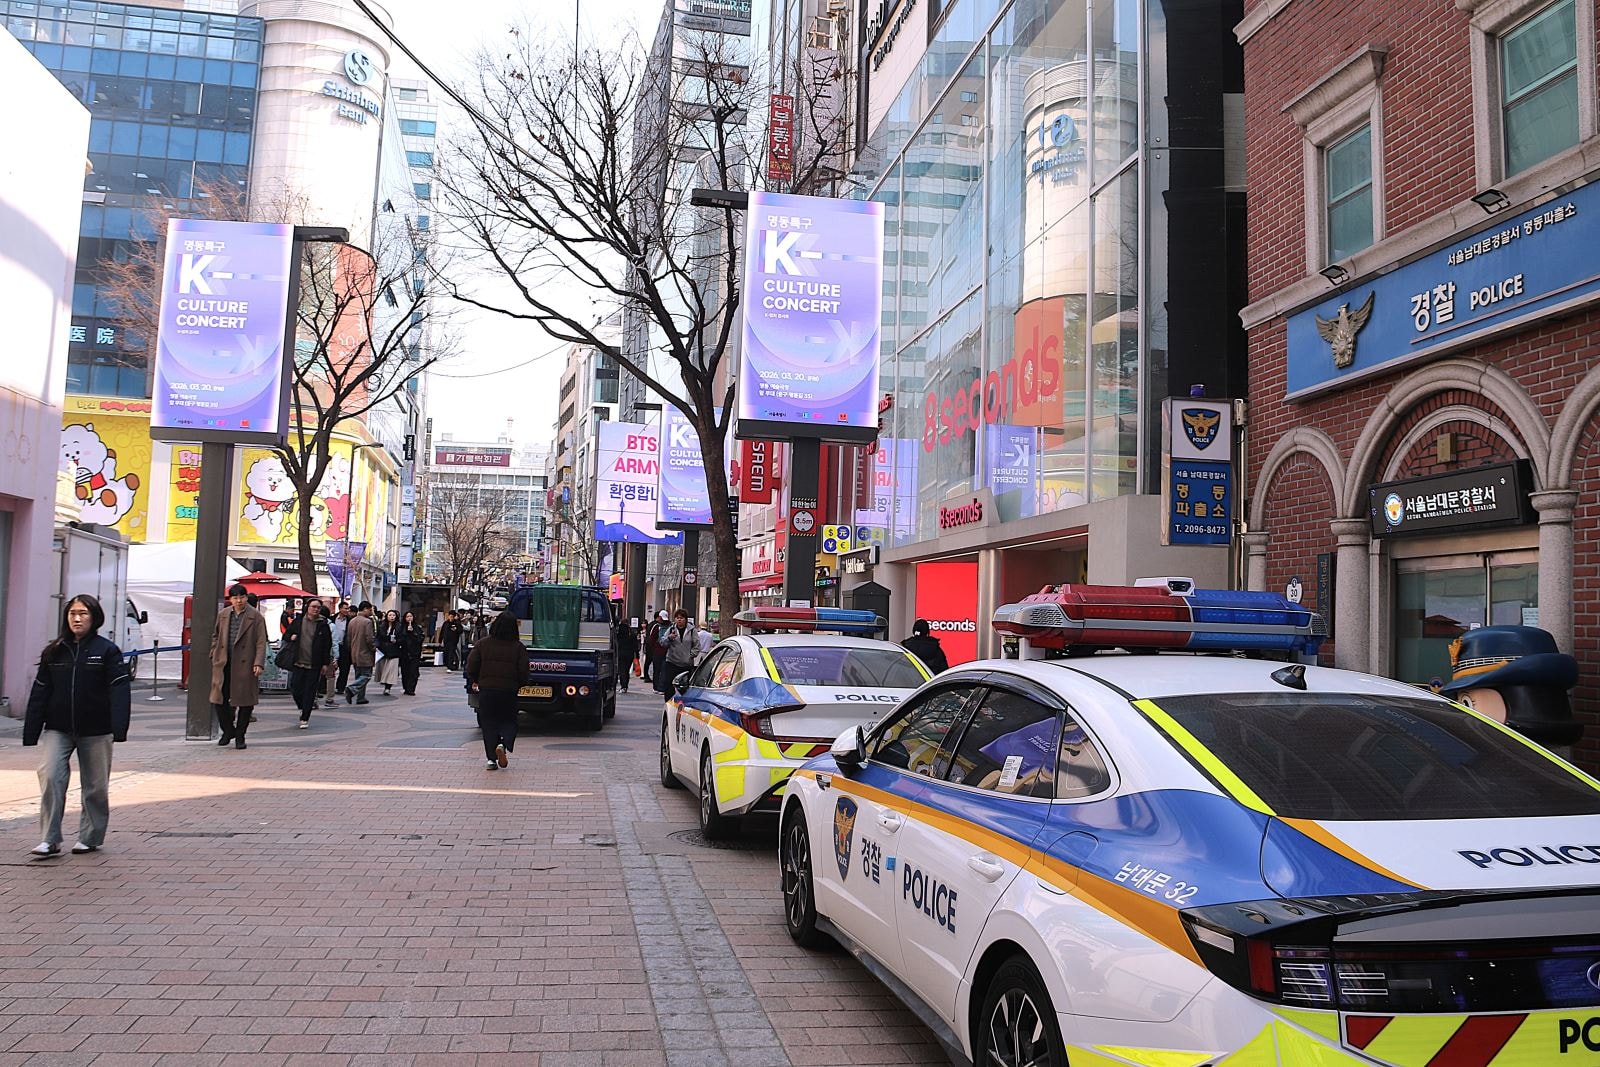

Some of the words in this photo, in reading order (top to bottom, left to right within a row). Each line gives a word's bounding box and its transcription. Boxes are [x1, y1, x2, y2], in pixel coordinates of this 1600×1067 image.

[322, 80, 379, 117] Shinhan
[338, 102, 367, 125] Bank
[770, 110, 791, 159] 부동산
[767, 215, 812, 229] 명동특구
[1447, 225, 1521, 266] 서울남대문경찰서
[1523, 202, 1576, 236] 명동파출소
[184, 240, 225, 252] 명동특구
[764, 230, 822, 276] K-
[179, 254, 234, 295] K-
[763, 280, 841, 297] CULTURE
[177, 299, 248, 314] CULTURE
[763, 296, 841, 314] CONCERT
[1411, 281, 1457, 332] 경찰
[1470, 273, 1524, 311] POLICE
[176, 314, 247, 329] CONCERT
[627, 435, 657, 452] BTS
[178, 450, 202, 466] BT
[670, 450, 702, 459] CULTU
[670, 458, 704, 467] CONCER
[614, 457, 659, 475] ARMY
[751, 442, 765, 491] SAEM
[1176, 470, 1188, 478] 서울
[1190, 470, 1226, 480] 남대문경찰서
[610, 483, 657, 501] 환영합
[1405, 485, 1496, 514] 서울남대문경찰서
[175, 505, 199, 519] SEO
[792, 501, 817, 509] 제한높이
[1454, 507, 1472, 515] POLICE
[795, 517, 813, 526] 3.5m
[1175, 524, 1182, 533] T.
[1184, 524, 1226, 534] 2096-8473
[278, 562, 299, 570] LINE
[1290, 589, 1298, 597] 30
[918, 618, 976, 631] seconds
[528, 661, 567, 672] OTORS
[834, 694, 901, 703] POLICE
[861, 838, 881, 884] 경찰
[1114, 861, 1172, 895] 남대문
[1164, 881, 1199, 905] 32
[903, 862, 957, 934] POLICE
